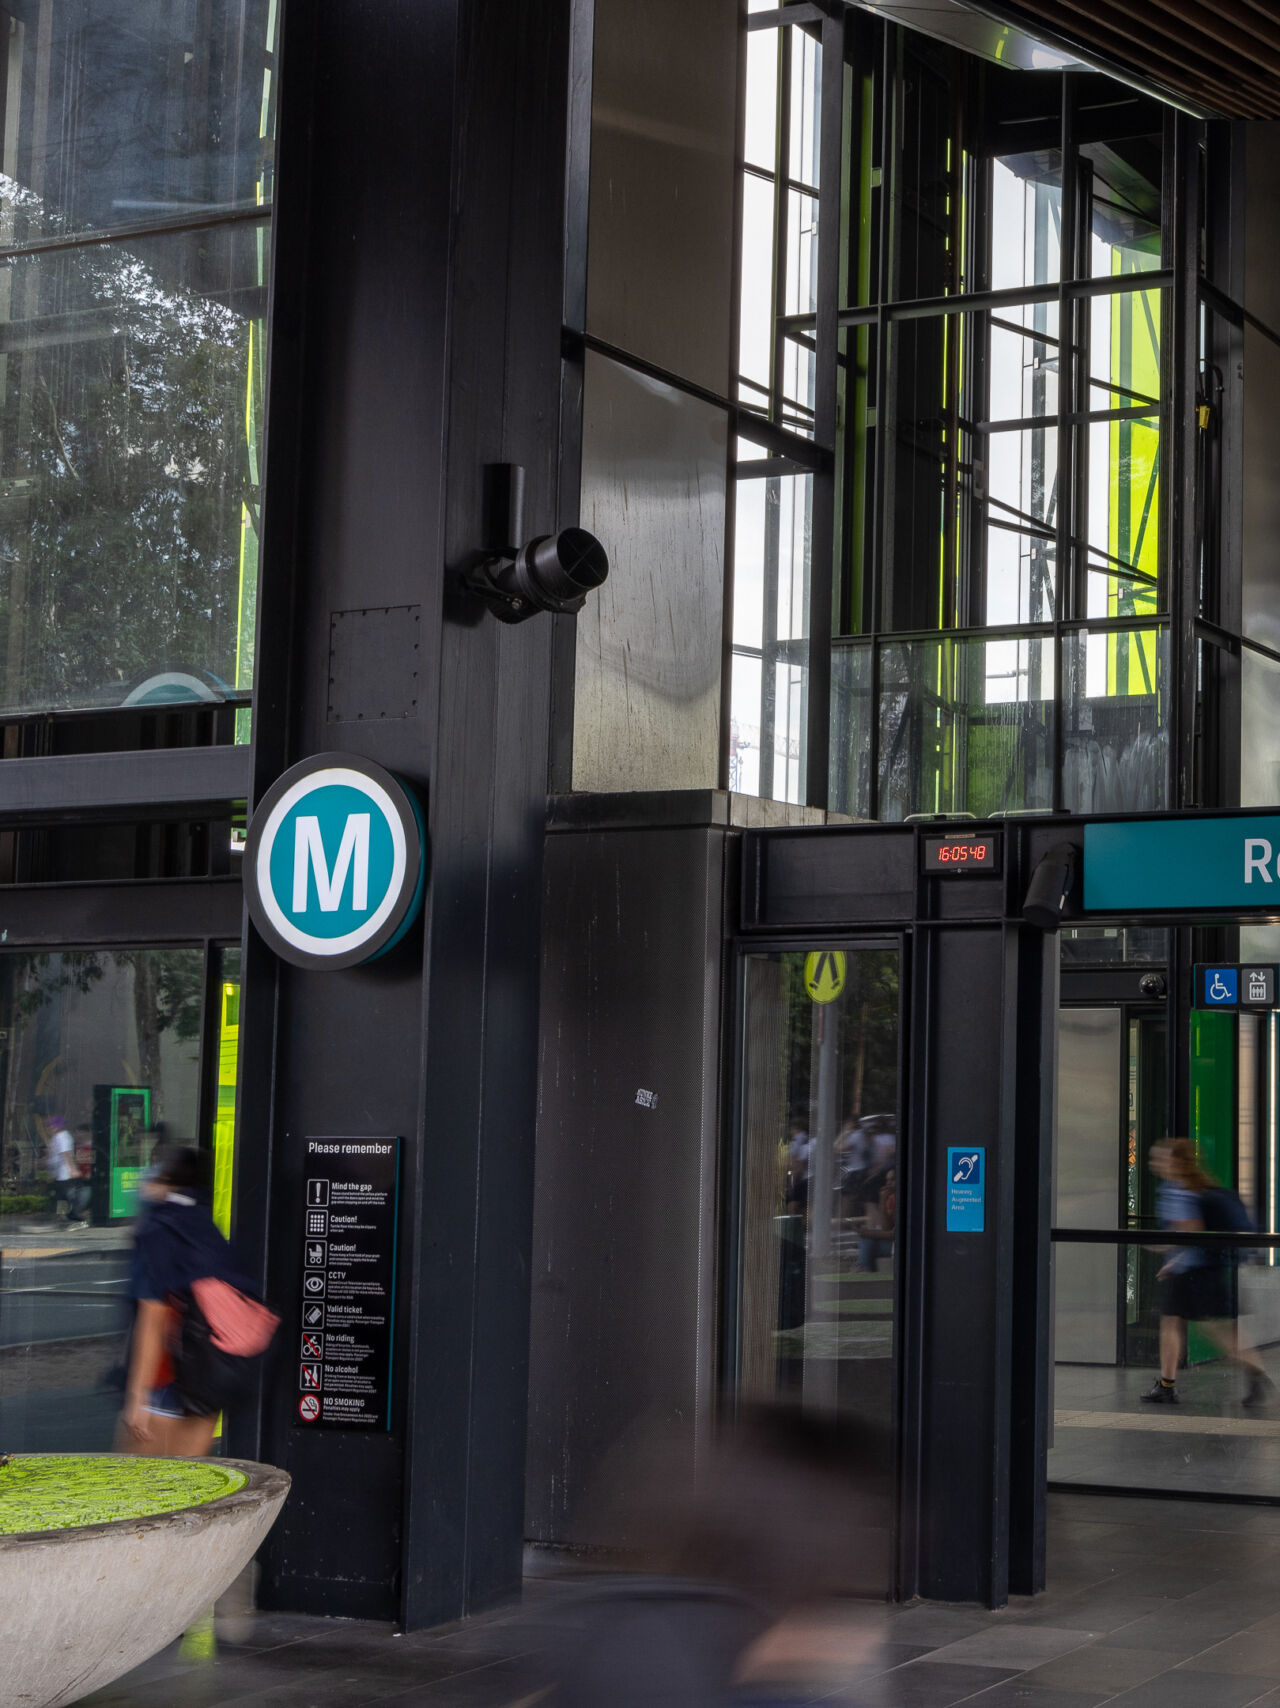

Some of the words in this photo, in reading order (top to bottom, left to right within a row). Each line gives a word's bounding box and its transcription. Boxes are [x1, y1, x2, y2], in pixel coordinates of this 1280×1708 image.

[292, 812, 371, 914] M
[308, 1142, 340, 1153] Please
[341, 1142, 392, 1154] remember
[331, 1182, 348, 1191] Mind
[348, 1182, 359, 1191] the
[360, 1183, 372, 1192] gap
[330, 1215, 358, 1223] Caution!
[329, 1243, 357, 1252] Caution!
[328, 1271, 346, 1279] CCTV
[327, 1304, 343, 1313] Valid
[344, 1305, 363, 1314] ticket
[326, 1333, 335, 1342] No
[336, 1334, 355, 1344] riding
[324, 1364, 334, 1373] No
[335, 1365, 359, 1374] alcohol
[323, 1397, 333, 1406] NO
[334, 1398, 365, 1408] SMOKING
